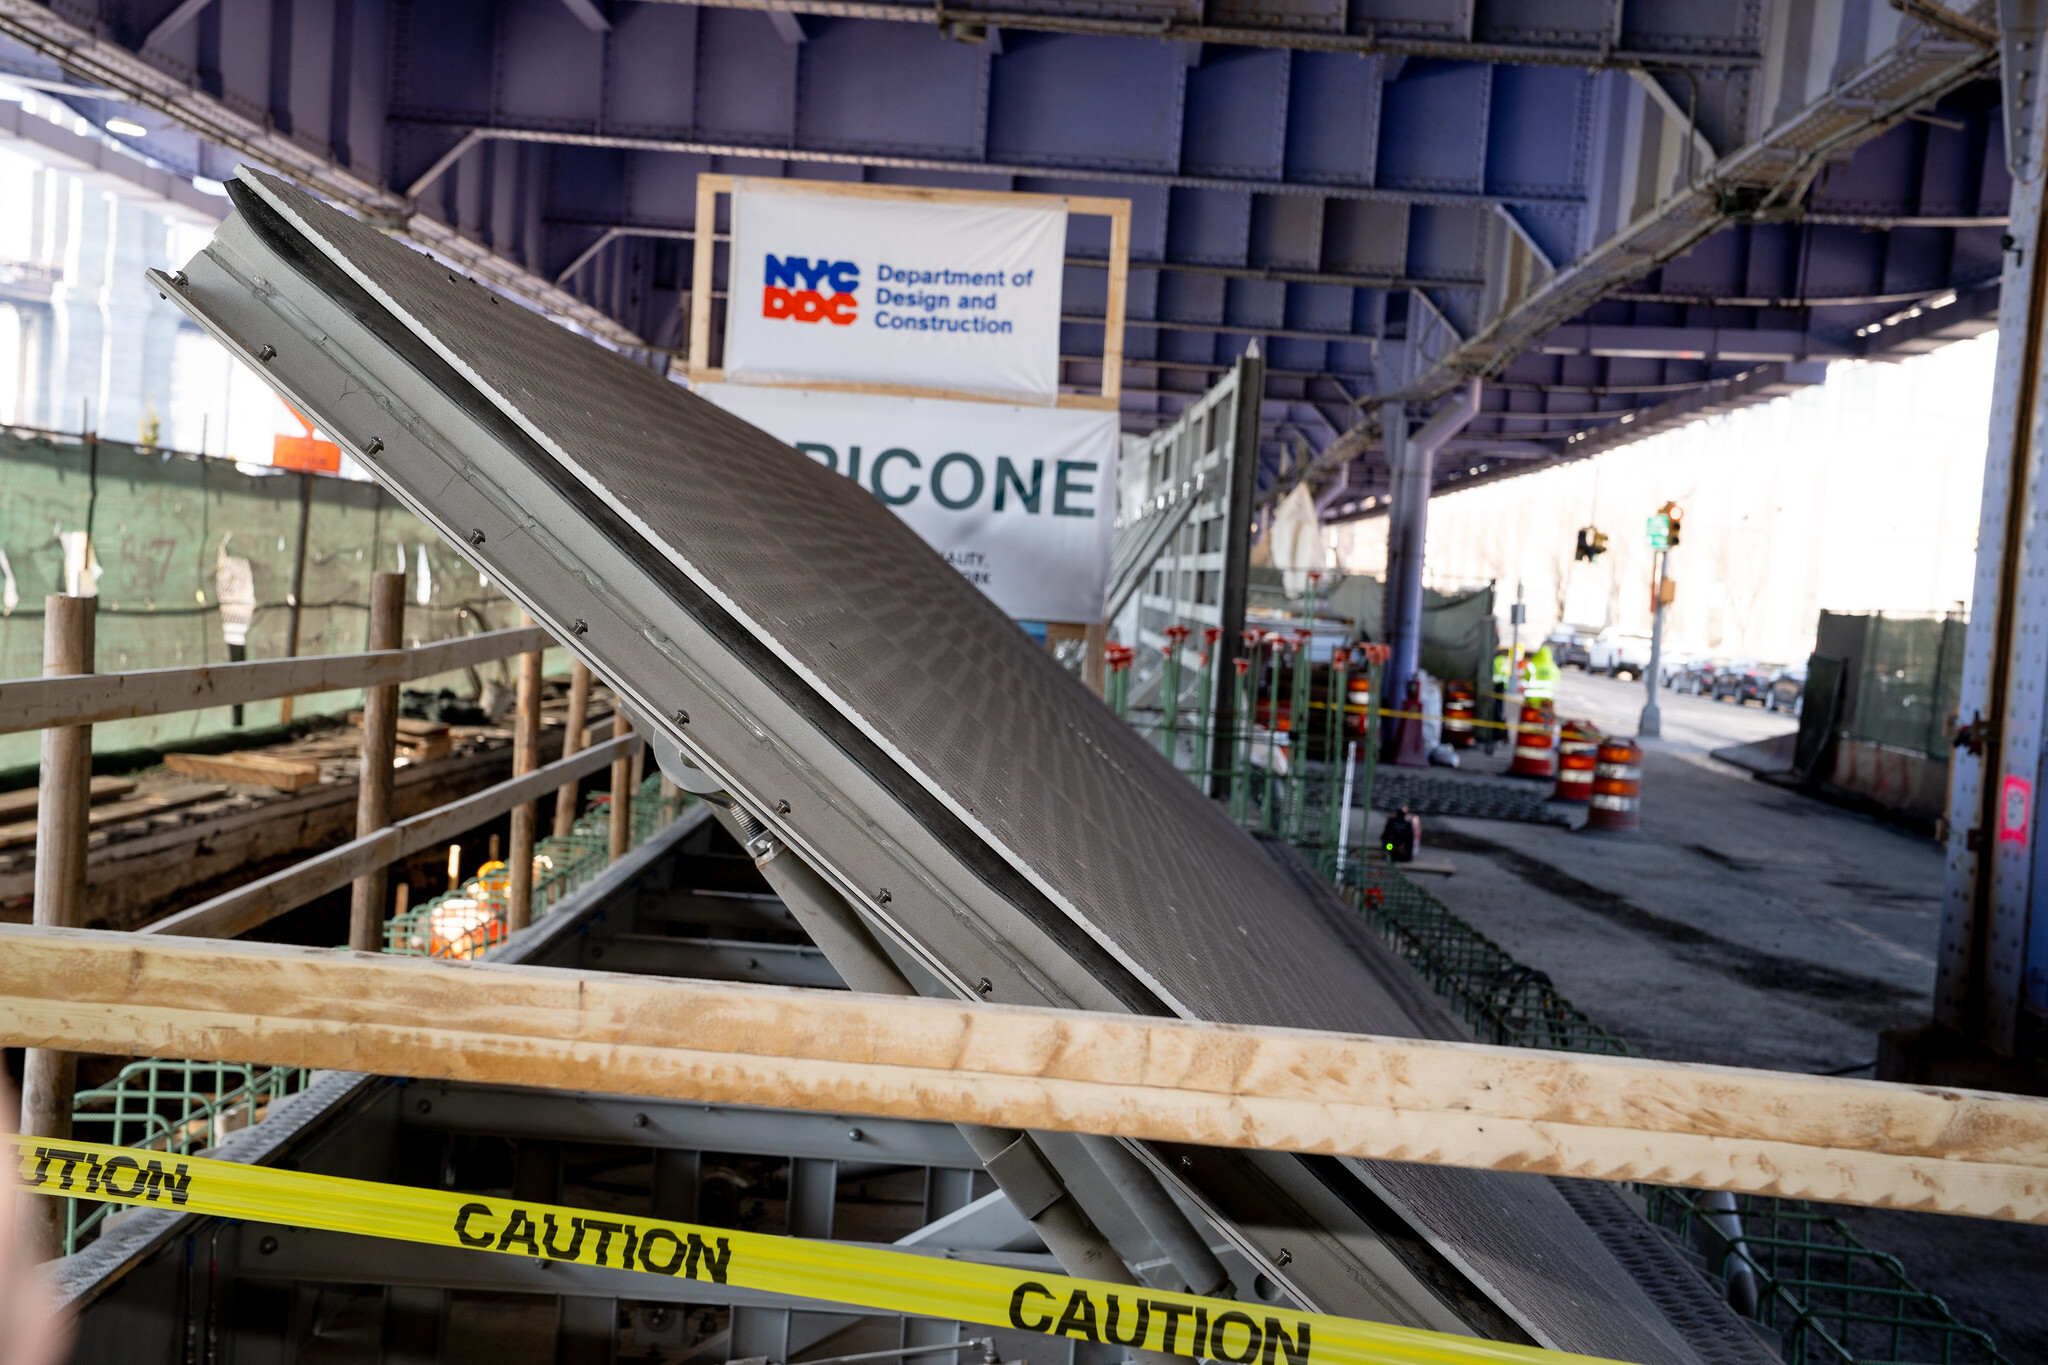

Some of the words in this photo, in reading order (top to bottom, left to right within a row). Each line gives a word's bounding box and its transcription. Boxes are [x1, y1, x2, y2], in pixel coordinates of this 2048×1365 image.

[765, 254, 860, 293] NYC
[877, 264, 1004, 287] Department
[1011, 269, 1034, 287] of
[763, 286, 858, 326] DDC
[876, 287, 950, 312] Design
[957, 293, 997, 310] and
[874, 310, 1013, 334] Construction
[454, 1203, 731, 1284] CAUTION
[1009, 1282, 1311, 1365] CAUTION
